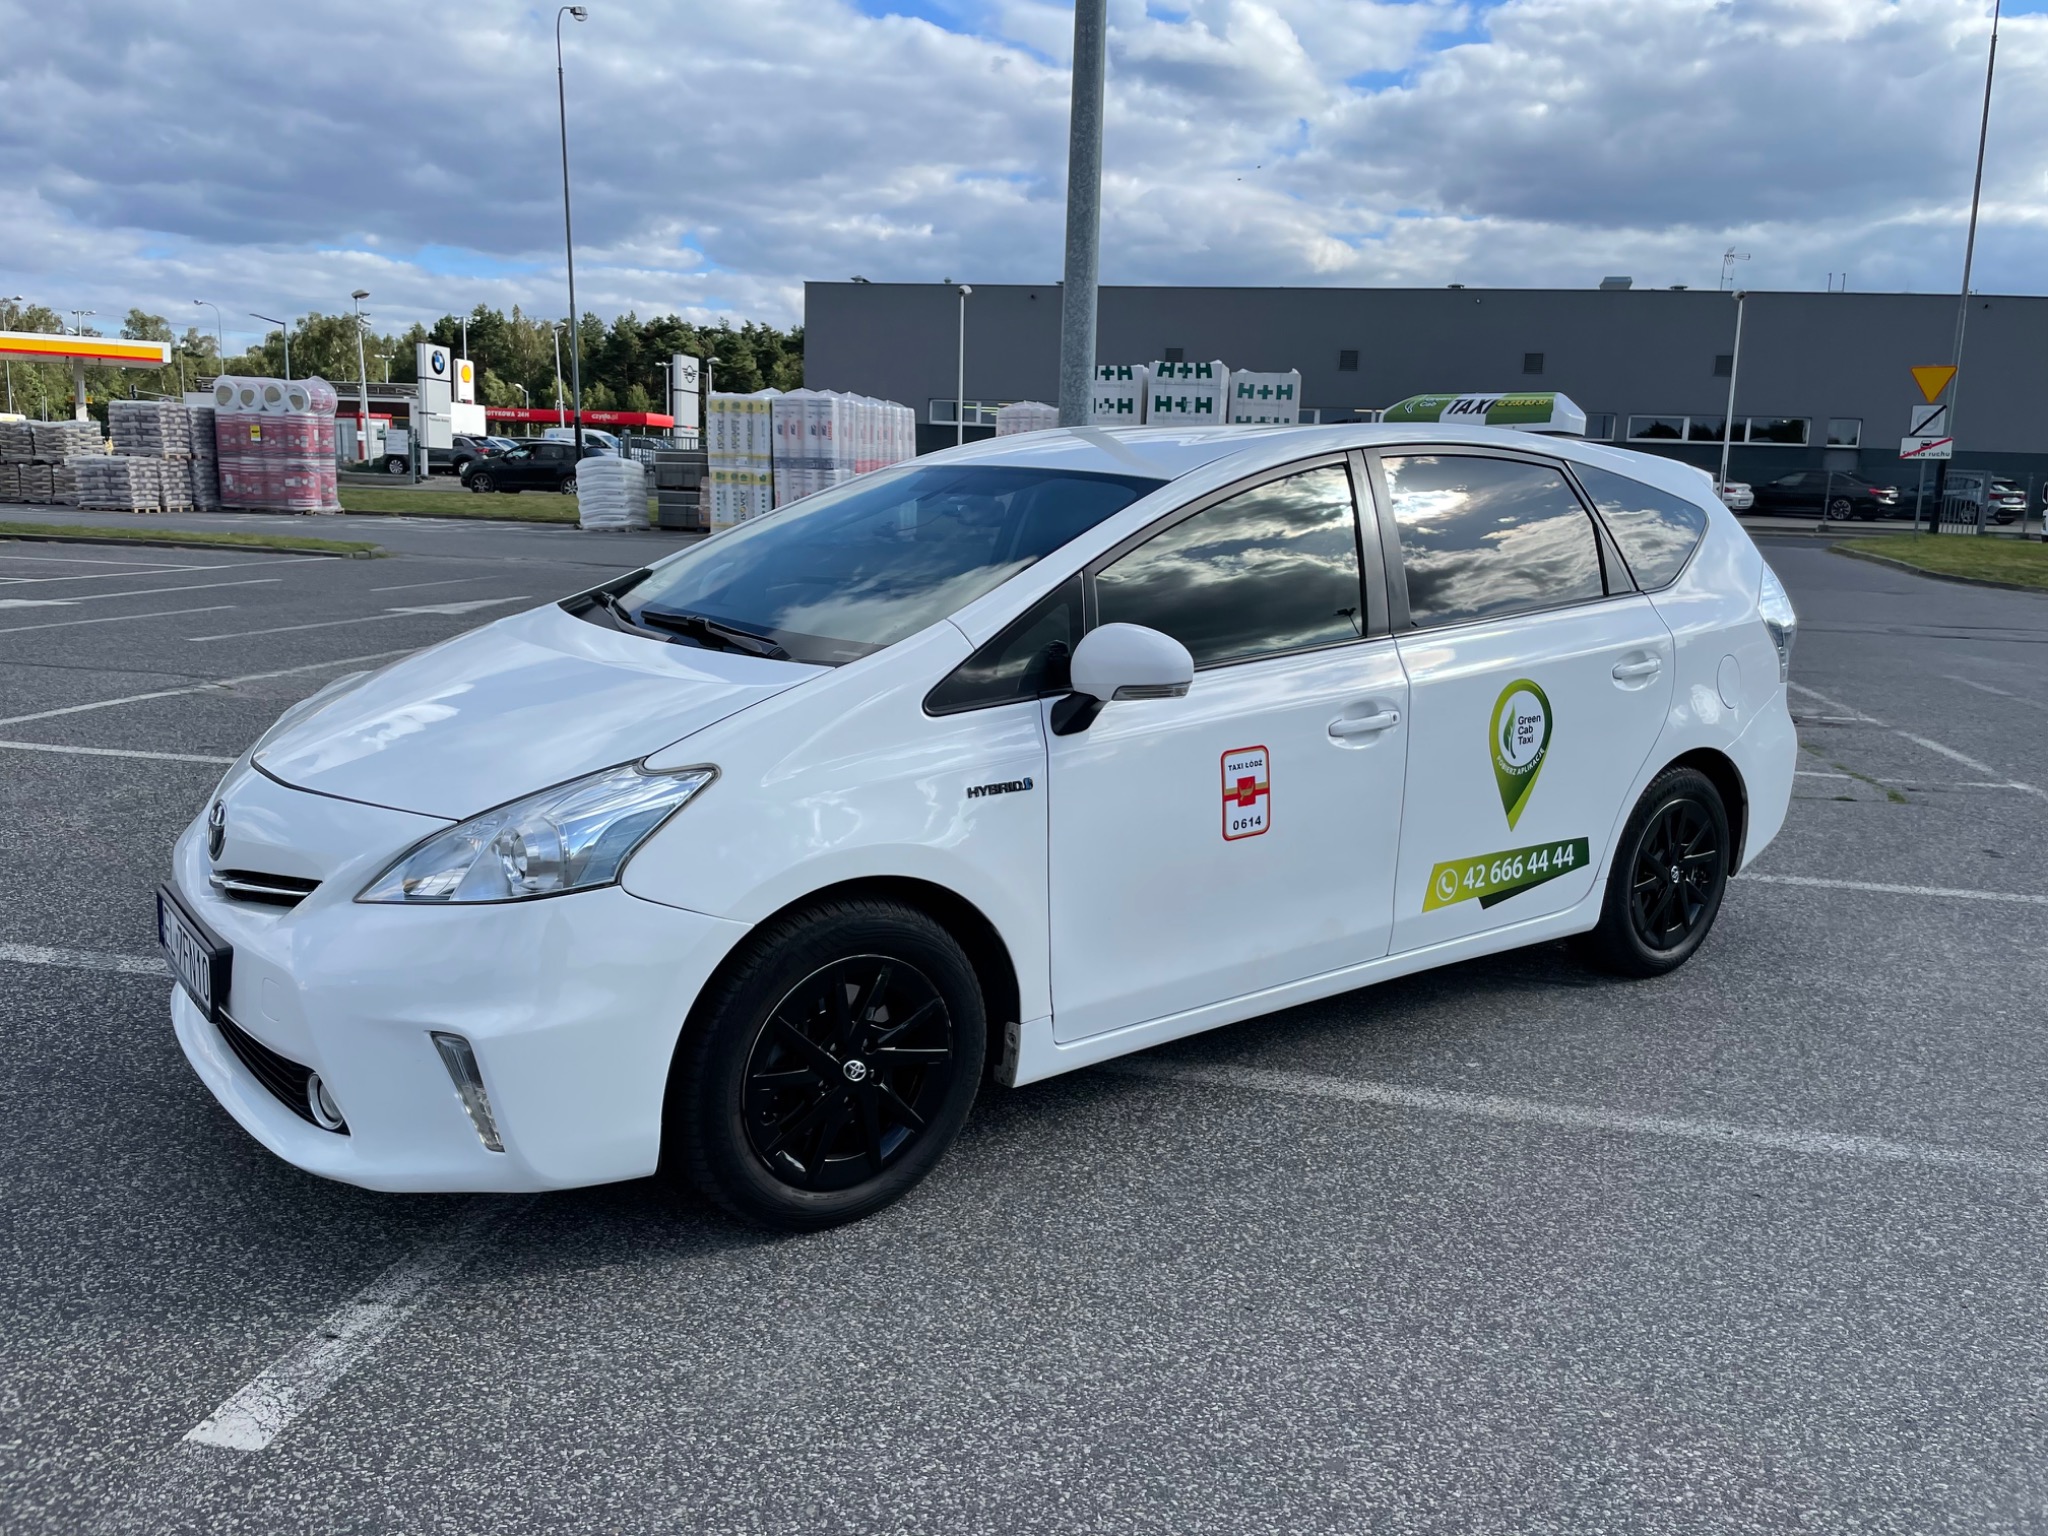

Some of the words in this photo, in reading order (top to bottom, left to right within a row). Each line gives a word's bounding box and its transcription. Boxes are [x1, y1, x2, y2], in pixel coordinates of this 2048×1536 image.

[1095, 366, 1133, 380] +H
[1157, 363, 1213, 379] H+H
[1237, 383, 1293, 400] H+H
[1094, 398, 1133, 414] +H
[1155, 395, 1212, 414] H+H
[1447, 399, 1497, 415] TAXI
[1518, 714, 1541, 725] Green
[1518, 725, 1534, 735] Cab
[1518, 734, 1534, 745] Taxi
[1228, 763, 1244, 771] TAXI
[967, 780, 1024, 799] HYBRID
[1232, 815, 1262, 831] 0614
[1463, 864, 1486, 889] 42
[1490, 855, 1523, 884] 666
[1527, 849, 1548, 875] 44
[1552, 843, 1574, 869] 44
